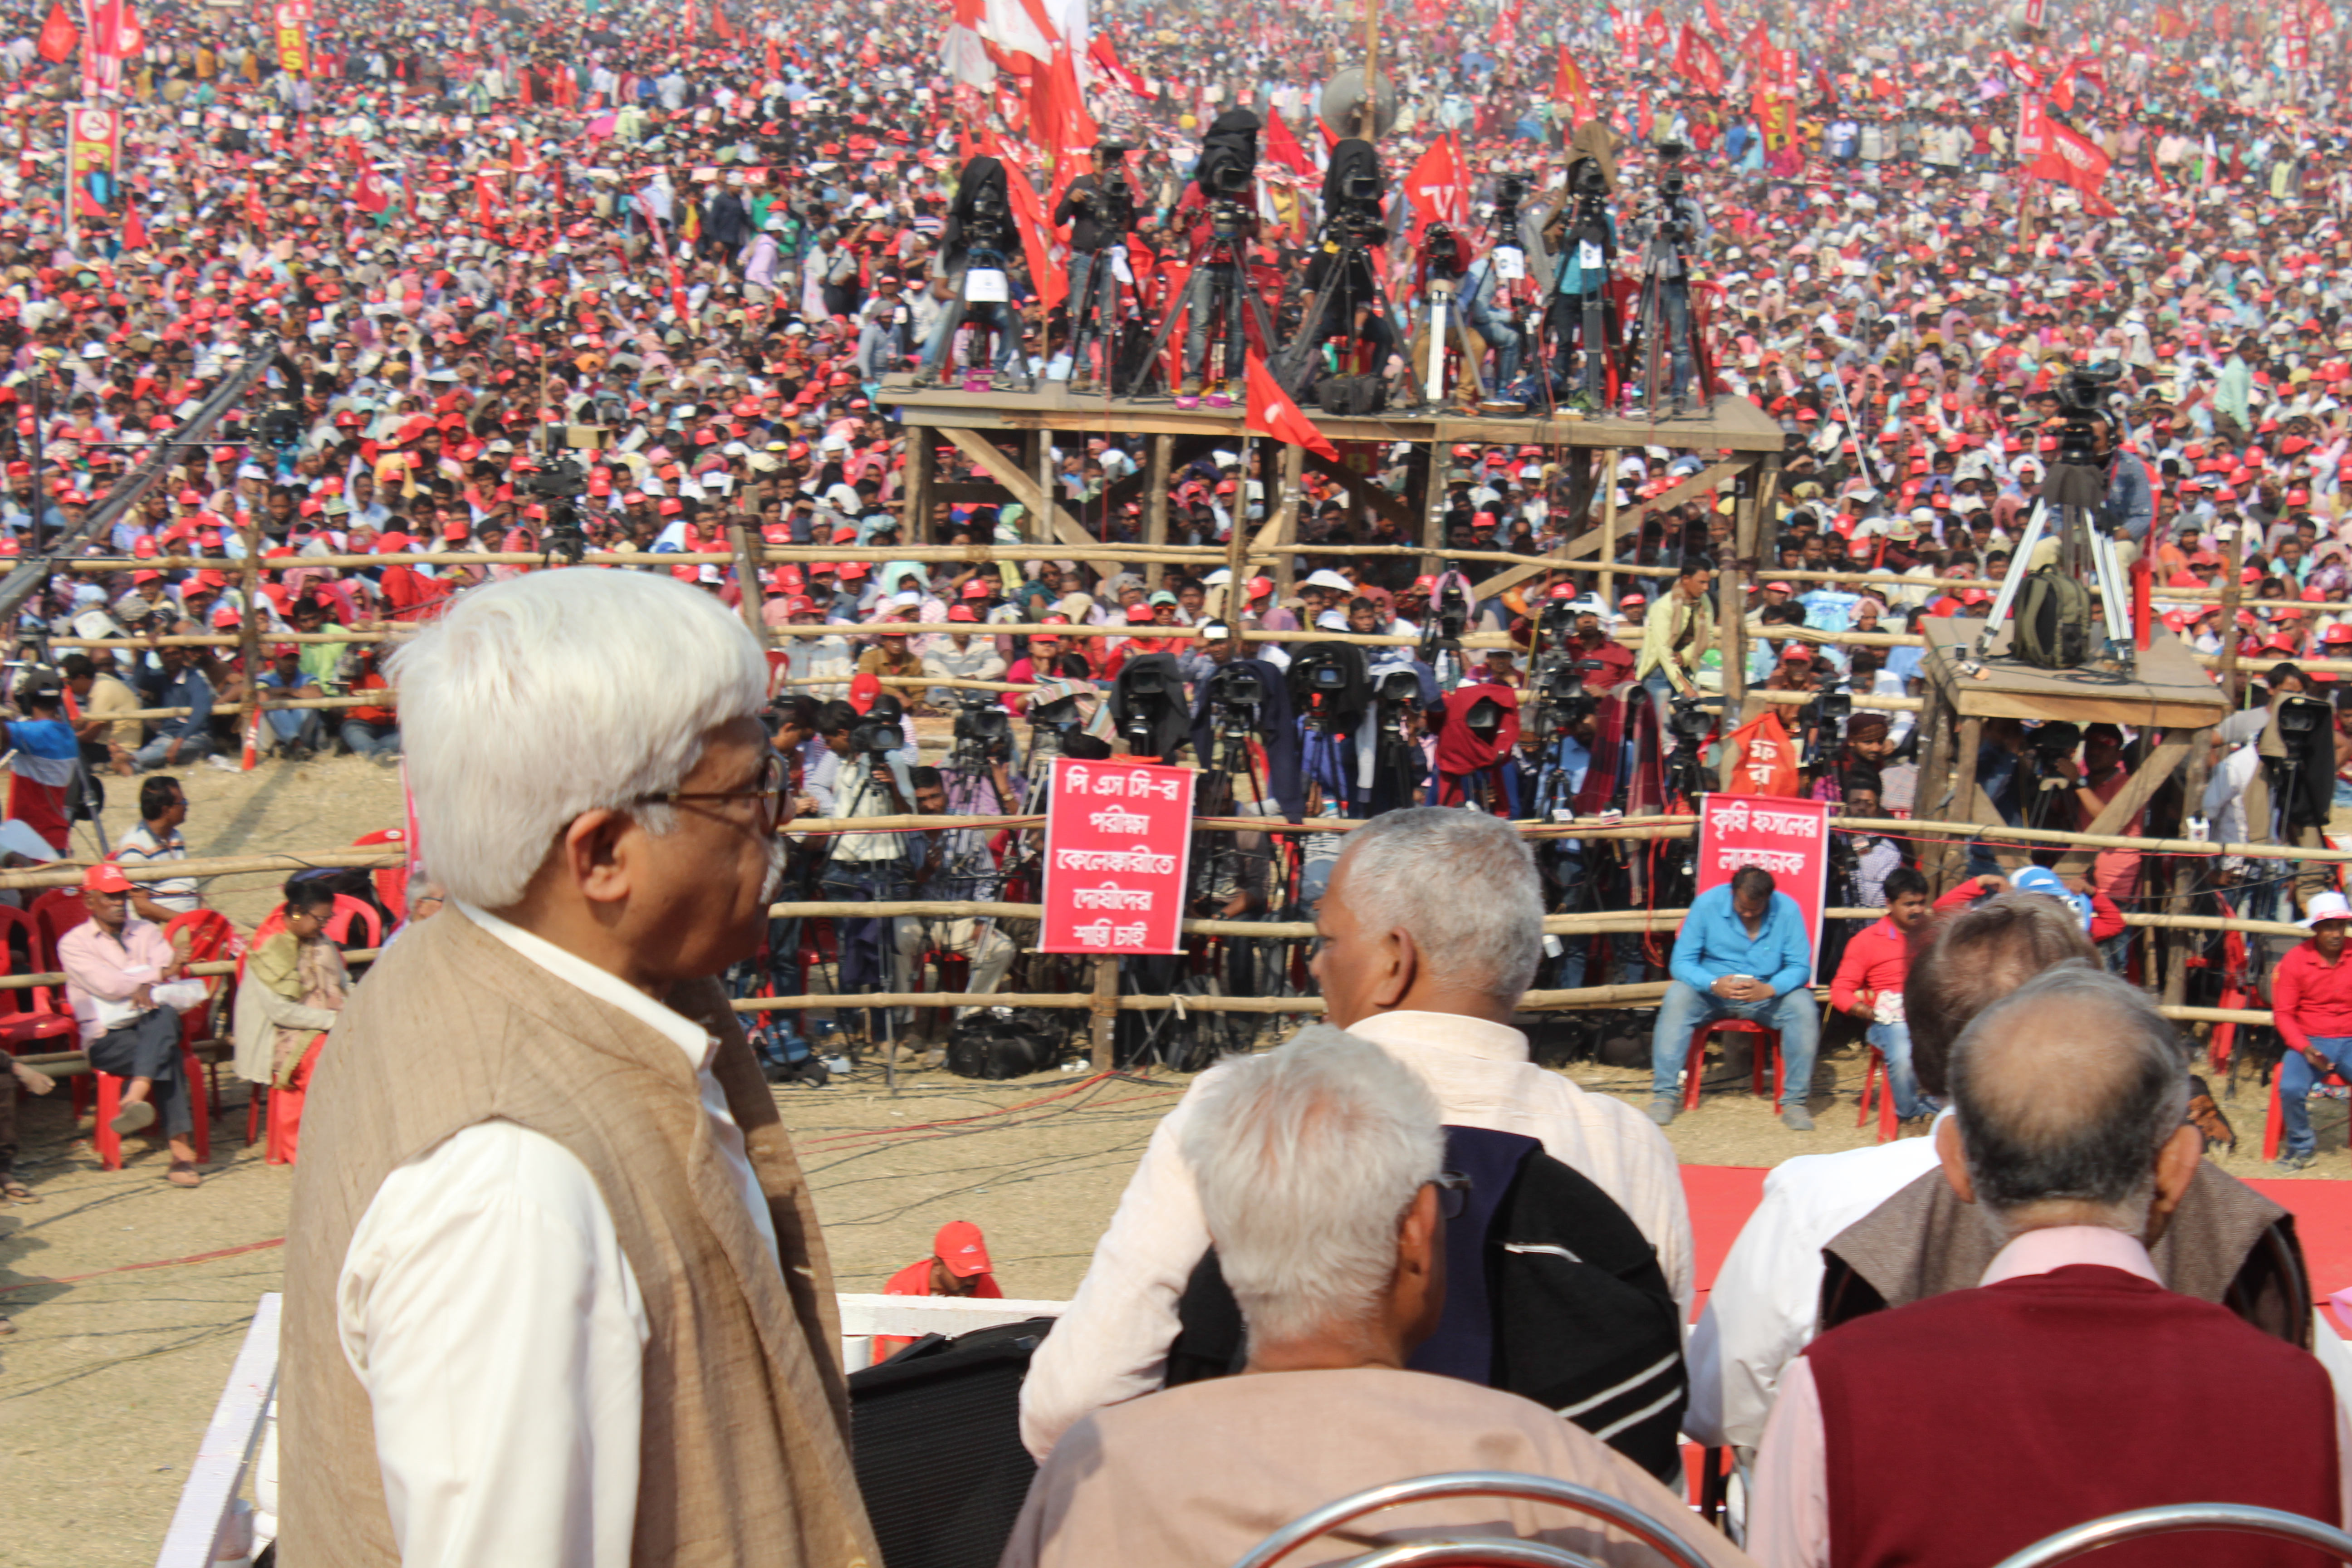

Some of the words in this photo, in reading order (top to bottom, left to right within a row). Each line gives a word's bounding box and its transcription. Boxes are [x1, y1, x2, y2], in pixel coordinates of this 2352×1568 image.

[1065, 765, 1090, 794] পি
[1092, 775, 1125, 796] এস
[1088, 804, 1151, 835] পরীক্ষা
[1710, 800, 1750, 841] কৃষি
[1751, 811, 1819, 838] ফসলের
[1073, 881, 1154, 911] দোষীদের
[1072, 917, 1113, 947] শাস্তি
[1114, 921, 1148, 948] চাই
